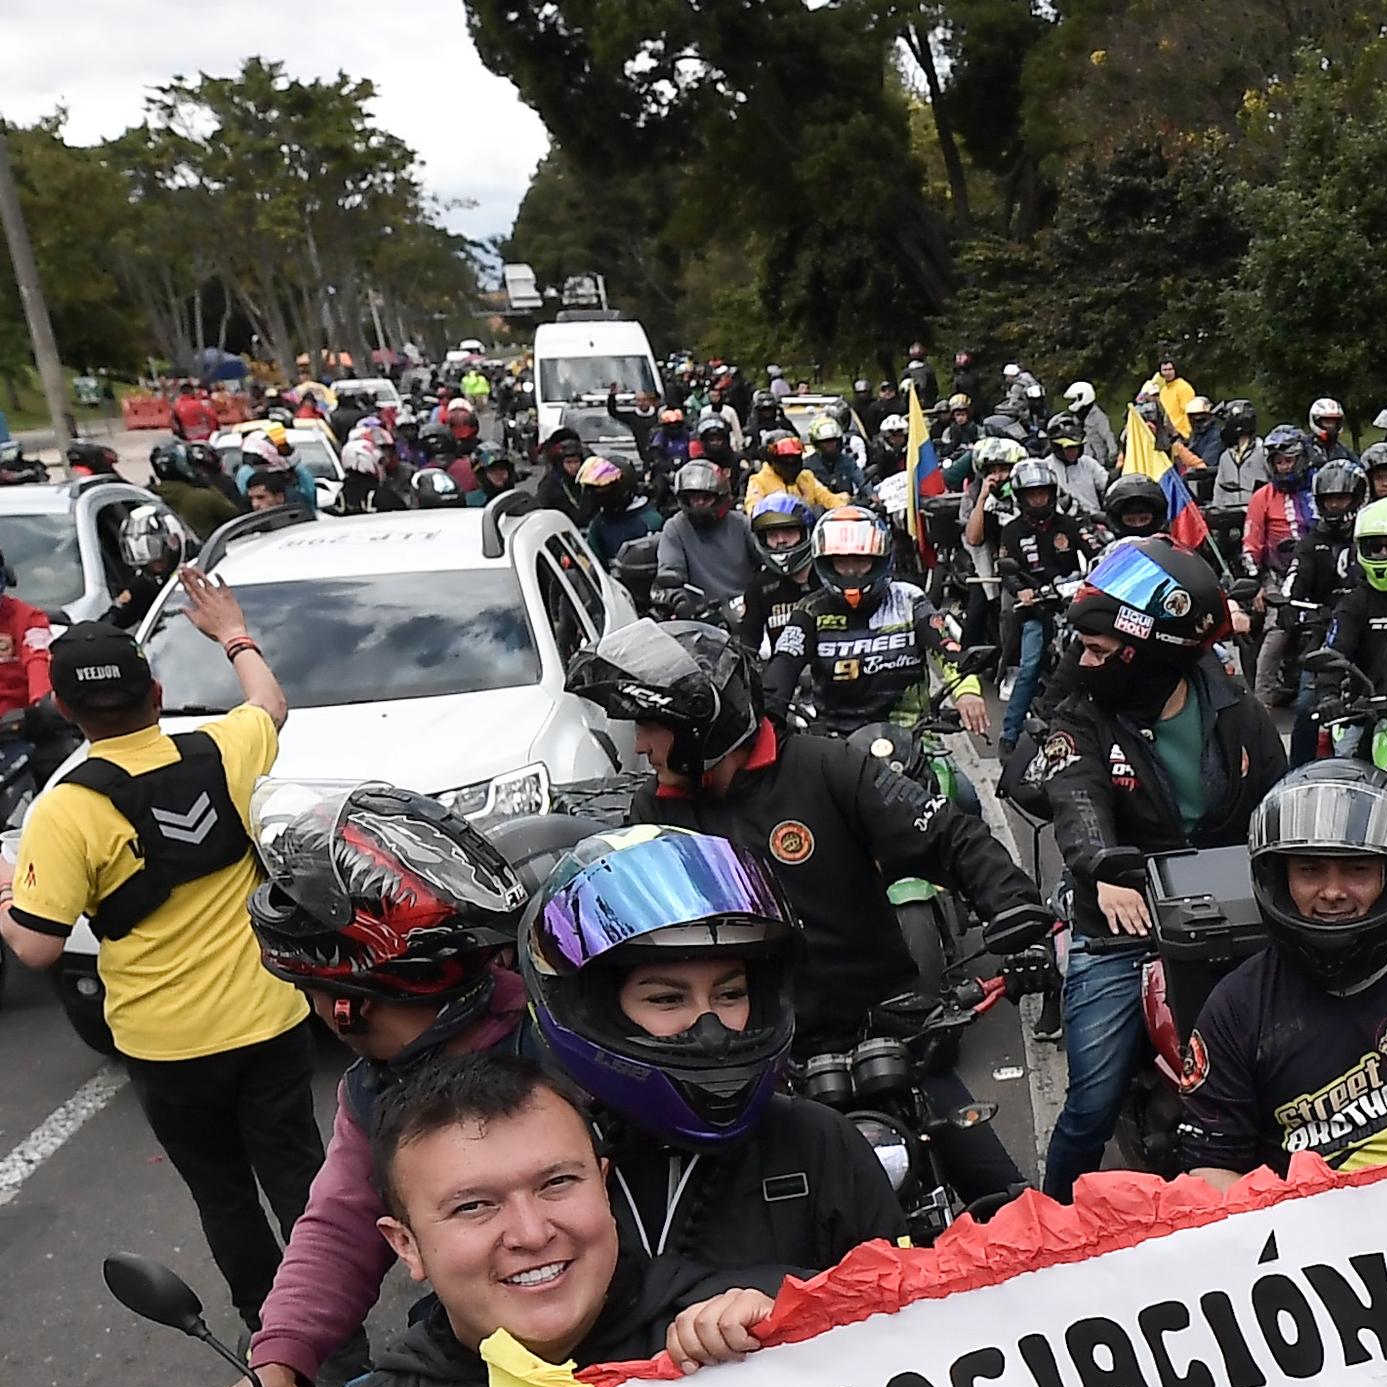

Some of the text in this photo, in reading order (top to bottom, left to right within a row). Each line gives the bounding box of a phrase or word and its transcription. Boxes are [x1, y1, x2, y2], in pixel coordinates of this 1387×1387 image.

[1115, 618, 1150, 639] MOLY
[817, 632, 916, 658] STREET
[76, 665, 122, 681] VEEDOR
